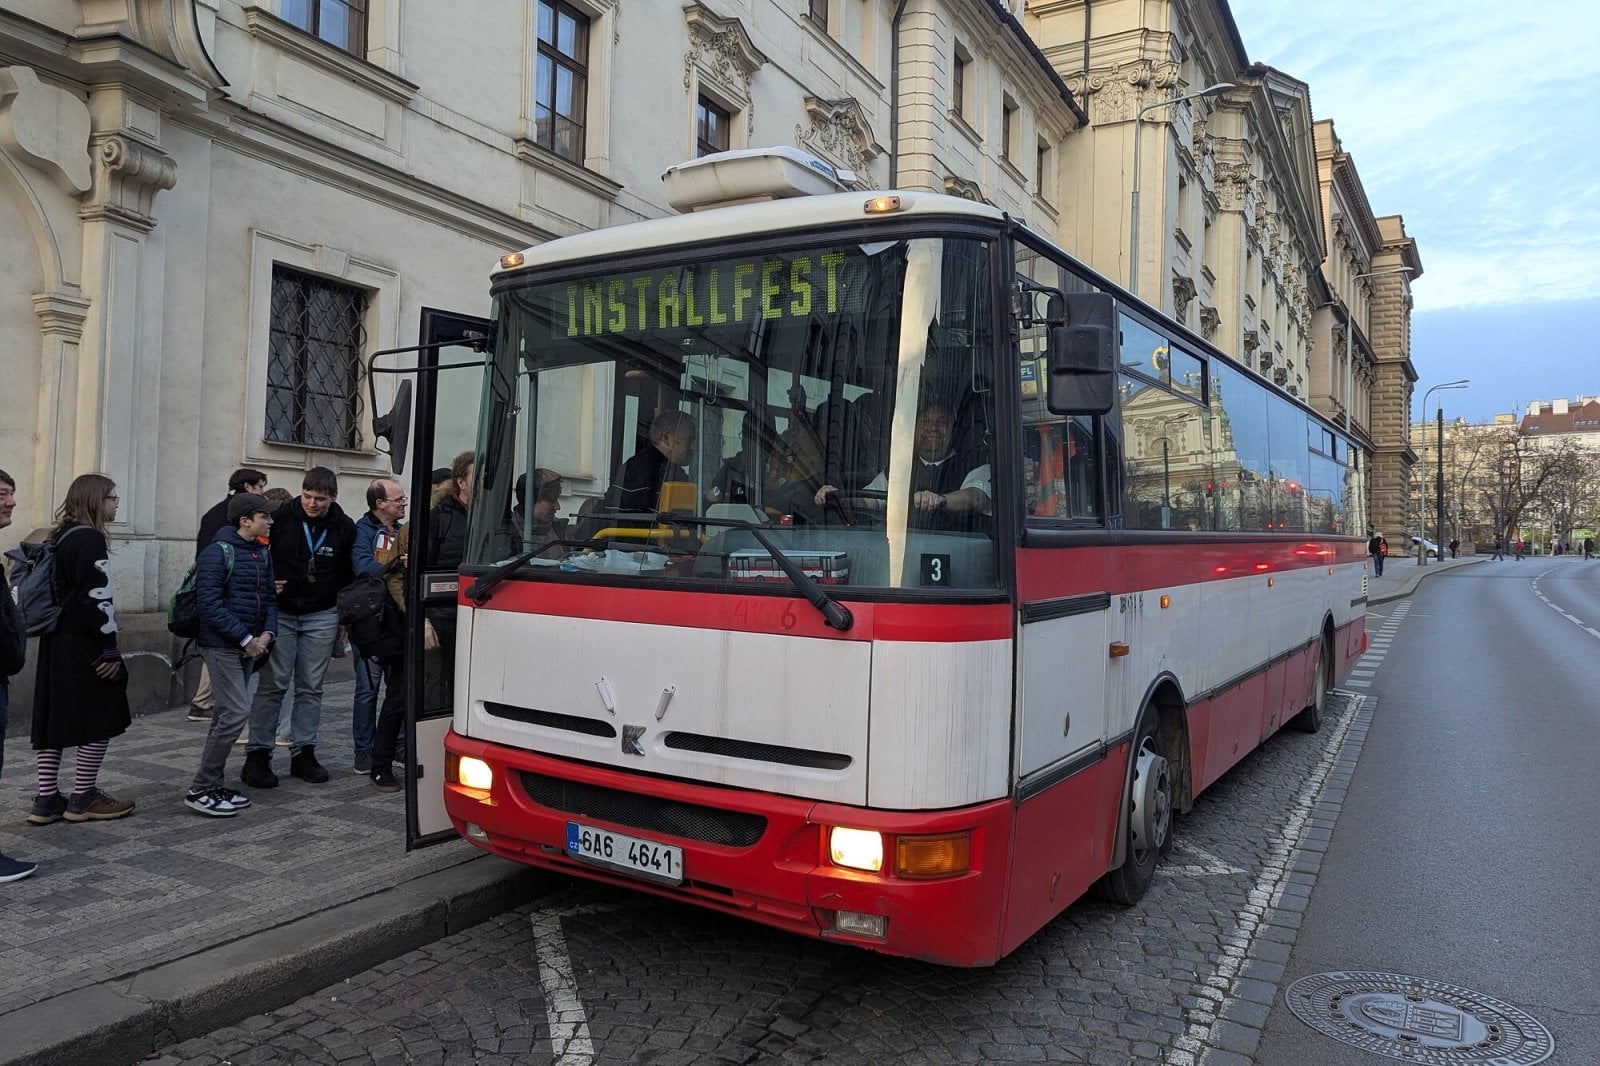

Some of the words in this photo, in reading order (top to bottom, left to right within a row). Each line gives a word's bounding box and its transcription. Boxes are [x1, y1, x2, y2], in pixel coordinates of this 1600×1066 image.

[567, 252, 845, 336] INSTALLFEST
[931, 557, 943, 582] 3
[569, 841, 578, 850] CZ
[582, 830, 614, 858] 6A6
[628, 841, 673, 874] 4641
